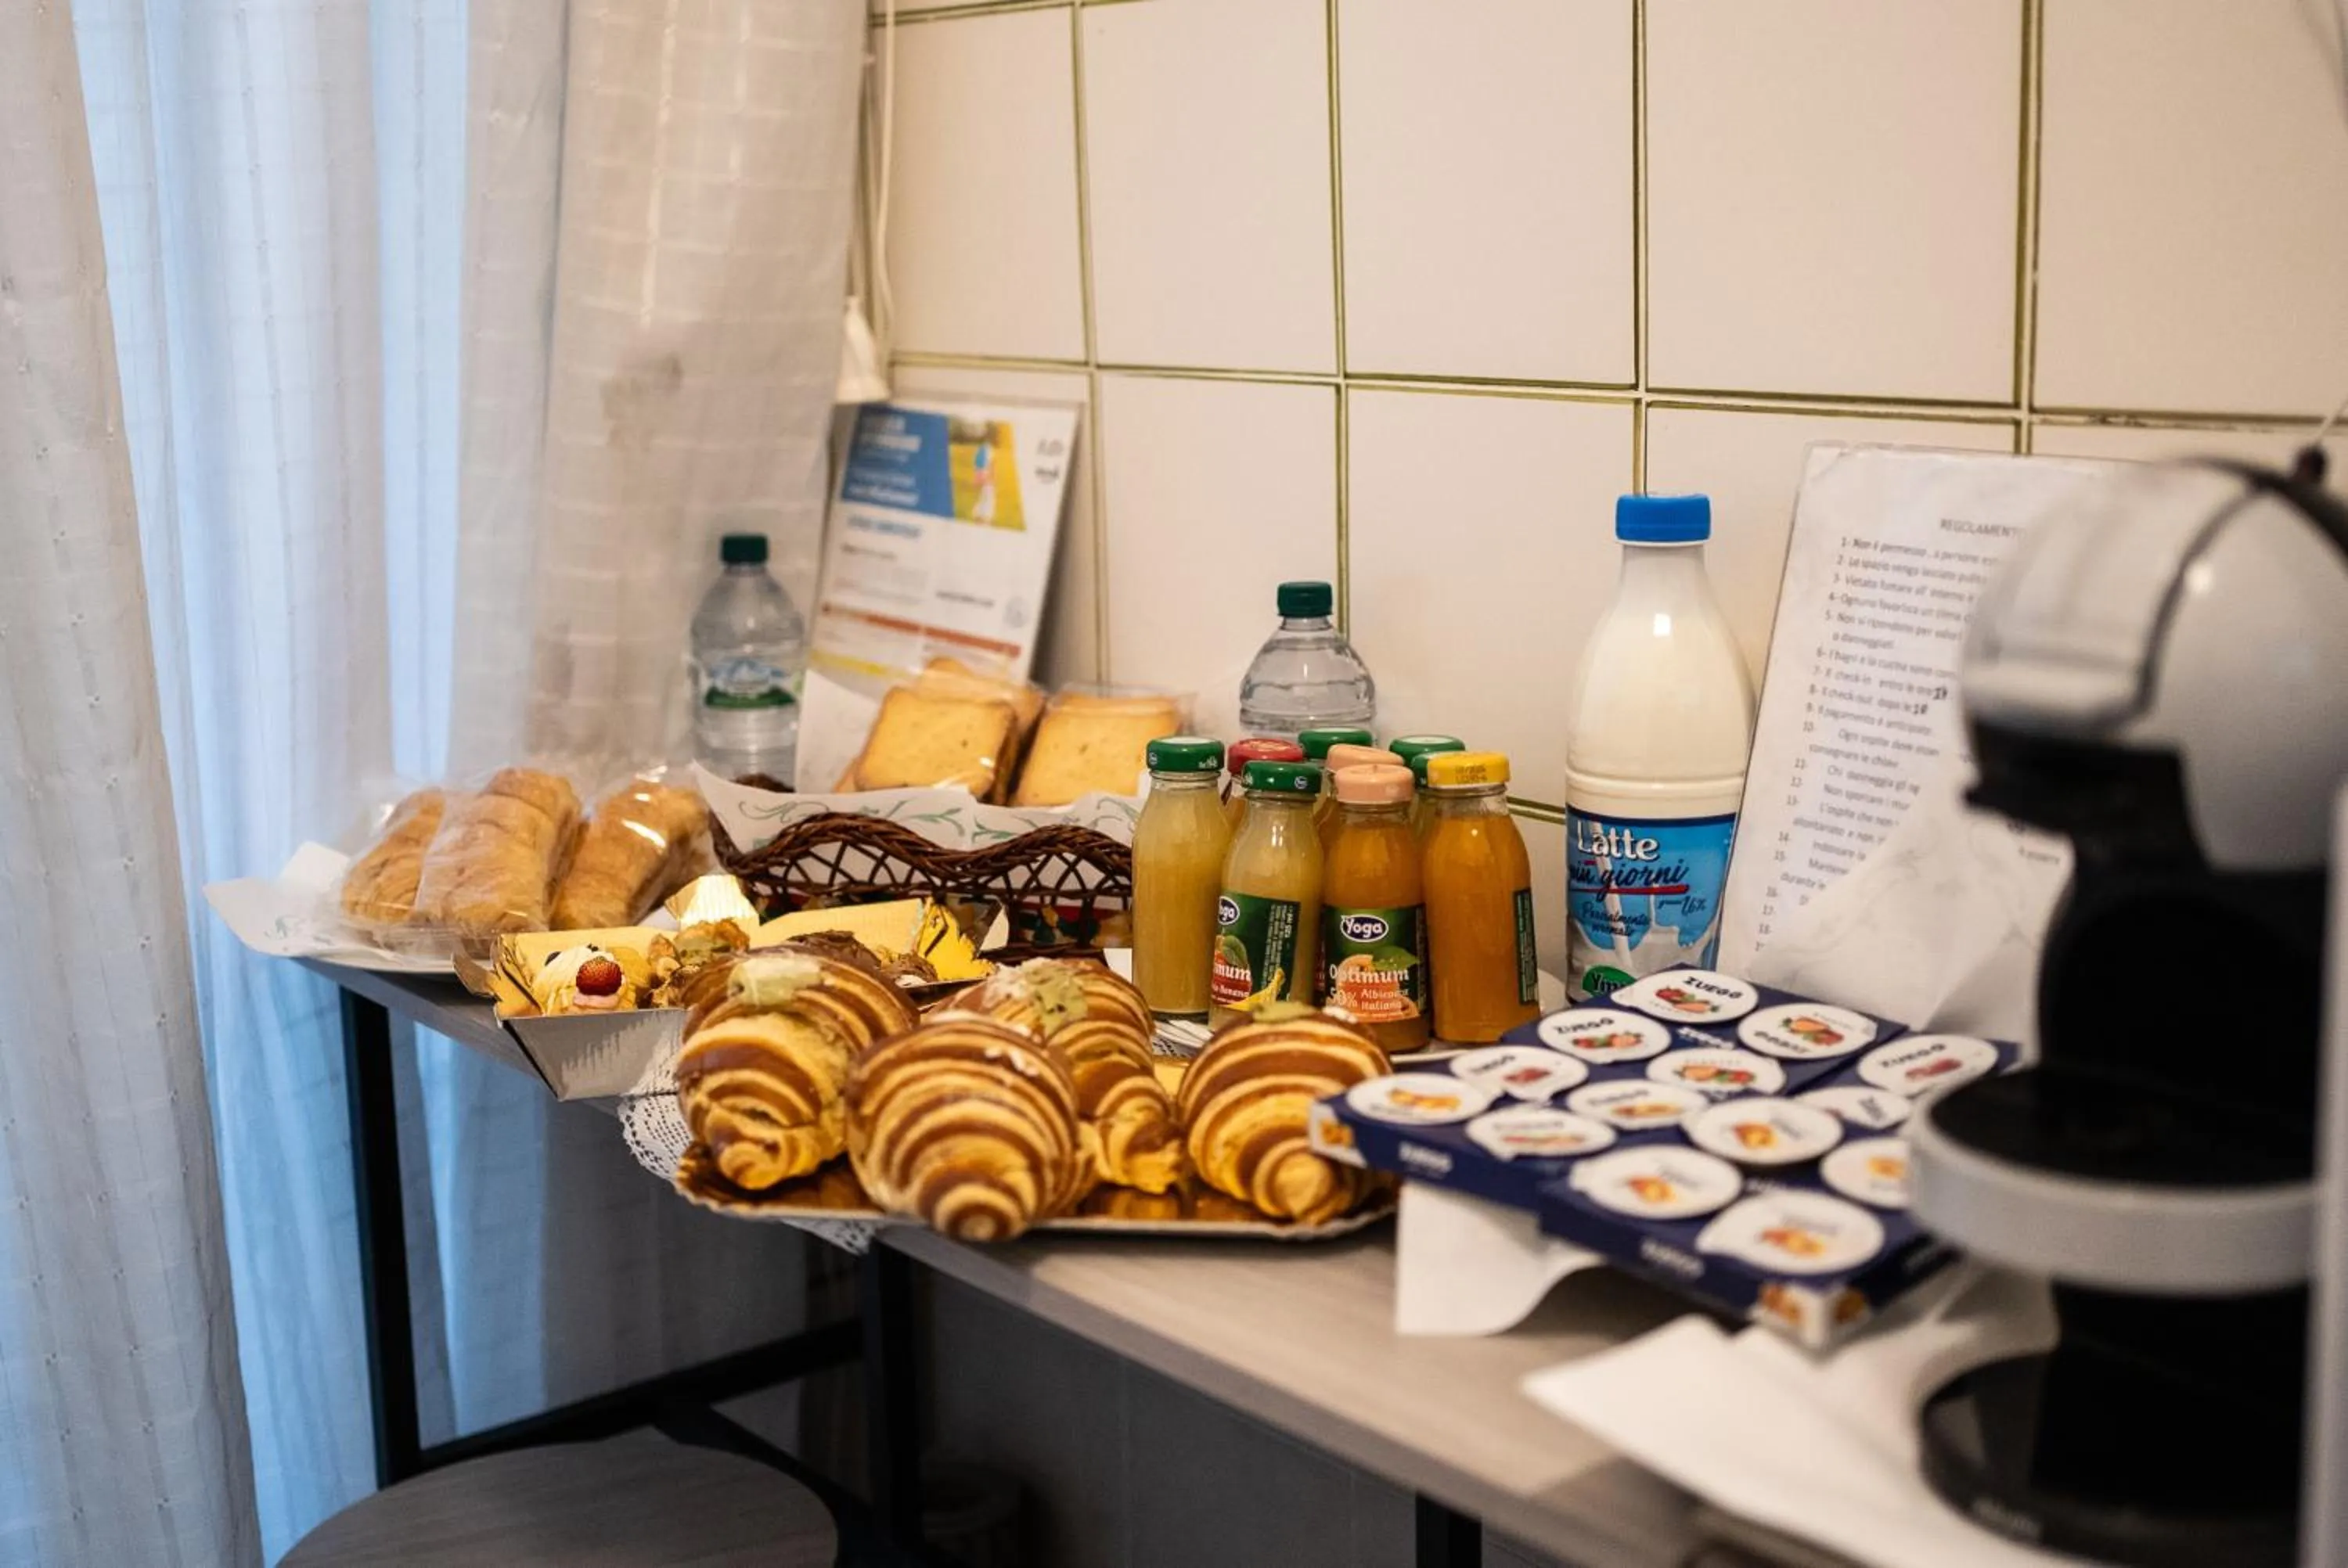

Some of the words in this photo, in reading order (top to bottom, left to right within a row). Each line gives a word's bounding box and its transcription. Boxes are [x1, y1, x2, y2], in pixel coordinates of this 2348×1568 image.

[1577, 820, 1660, 861] Latte
[1597, 860, 1689, 901] giorni
[1219, 905, 1235, 922] oga
[1345, 918, 1383, 938] Yoga
[1330, 963, 1409, 984] Optimum
